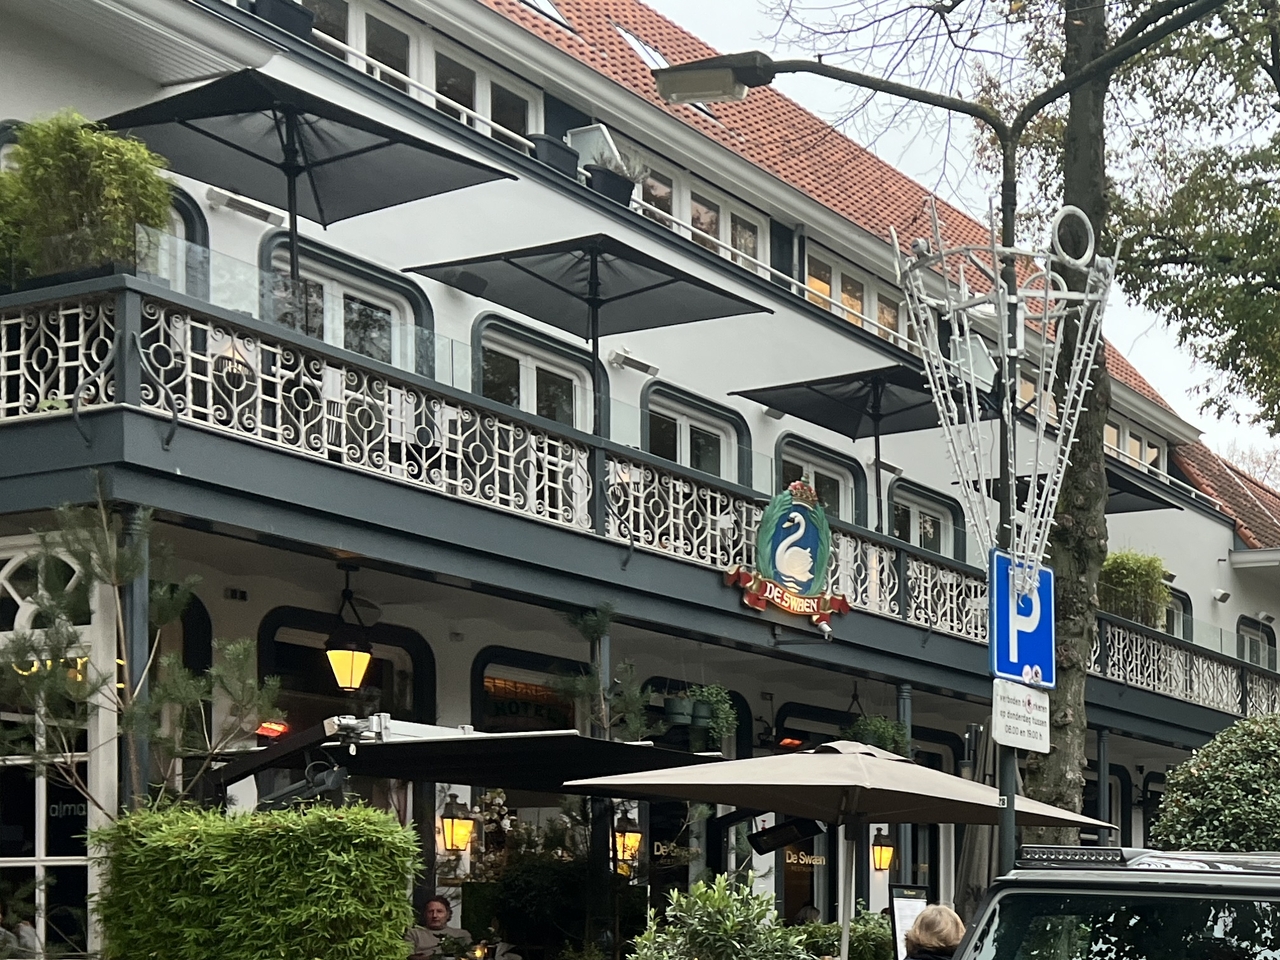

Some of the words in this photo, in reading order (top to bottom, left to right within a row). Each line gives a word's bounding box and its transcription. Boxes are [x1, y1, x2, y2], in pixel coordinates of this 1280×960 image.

[763, 581, 783, 604] DE
[782, 593, 818, 613] SWAEN
[1008, 565, 1041, 664] P
[1000, 694, 1021, 707] verboden
[1000, 710, 1006, 719] op
[1007, 710, 1031, 726] donderdag
[1032, 716, 1048, 728] tussen
[785, 850, 798, 864] De
[798, 851, 826, 866] Swaen
